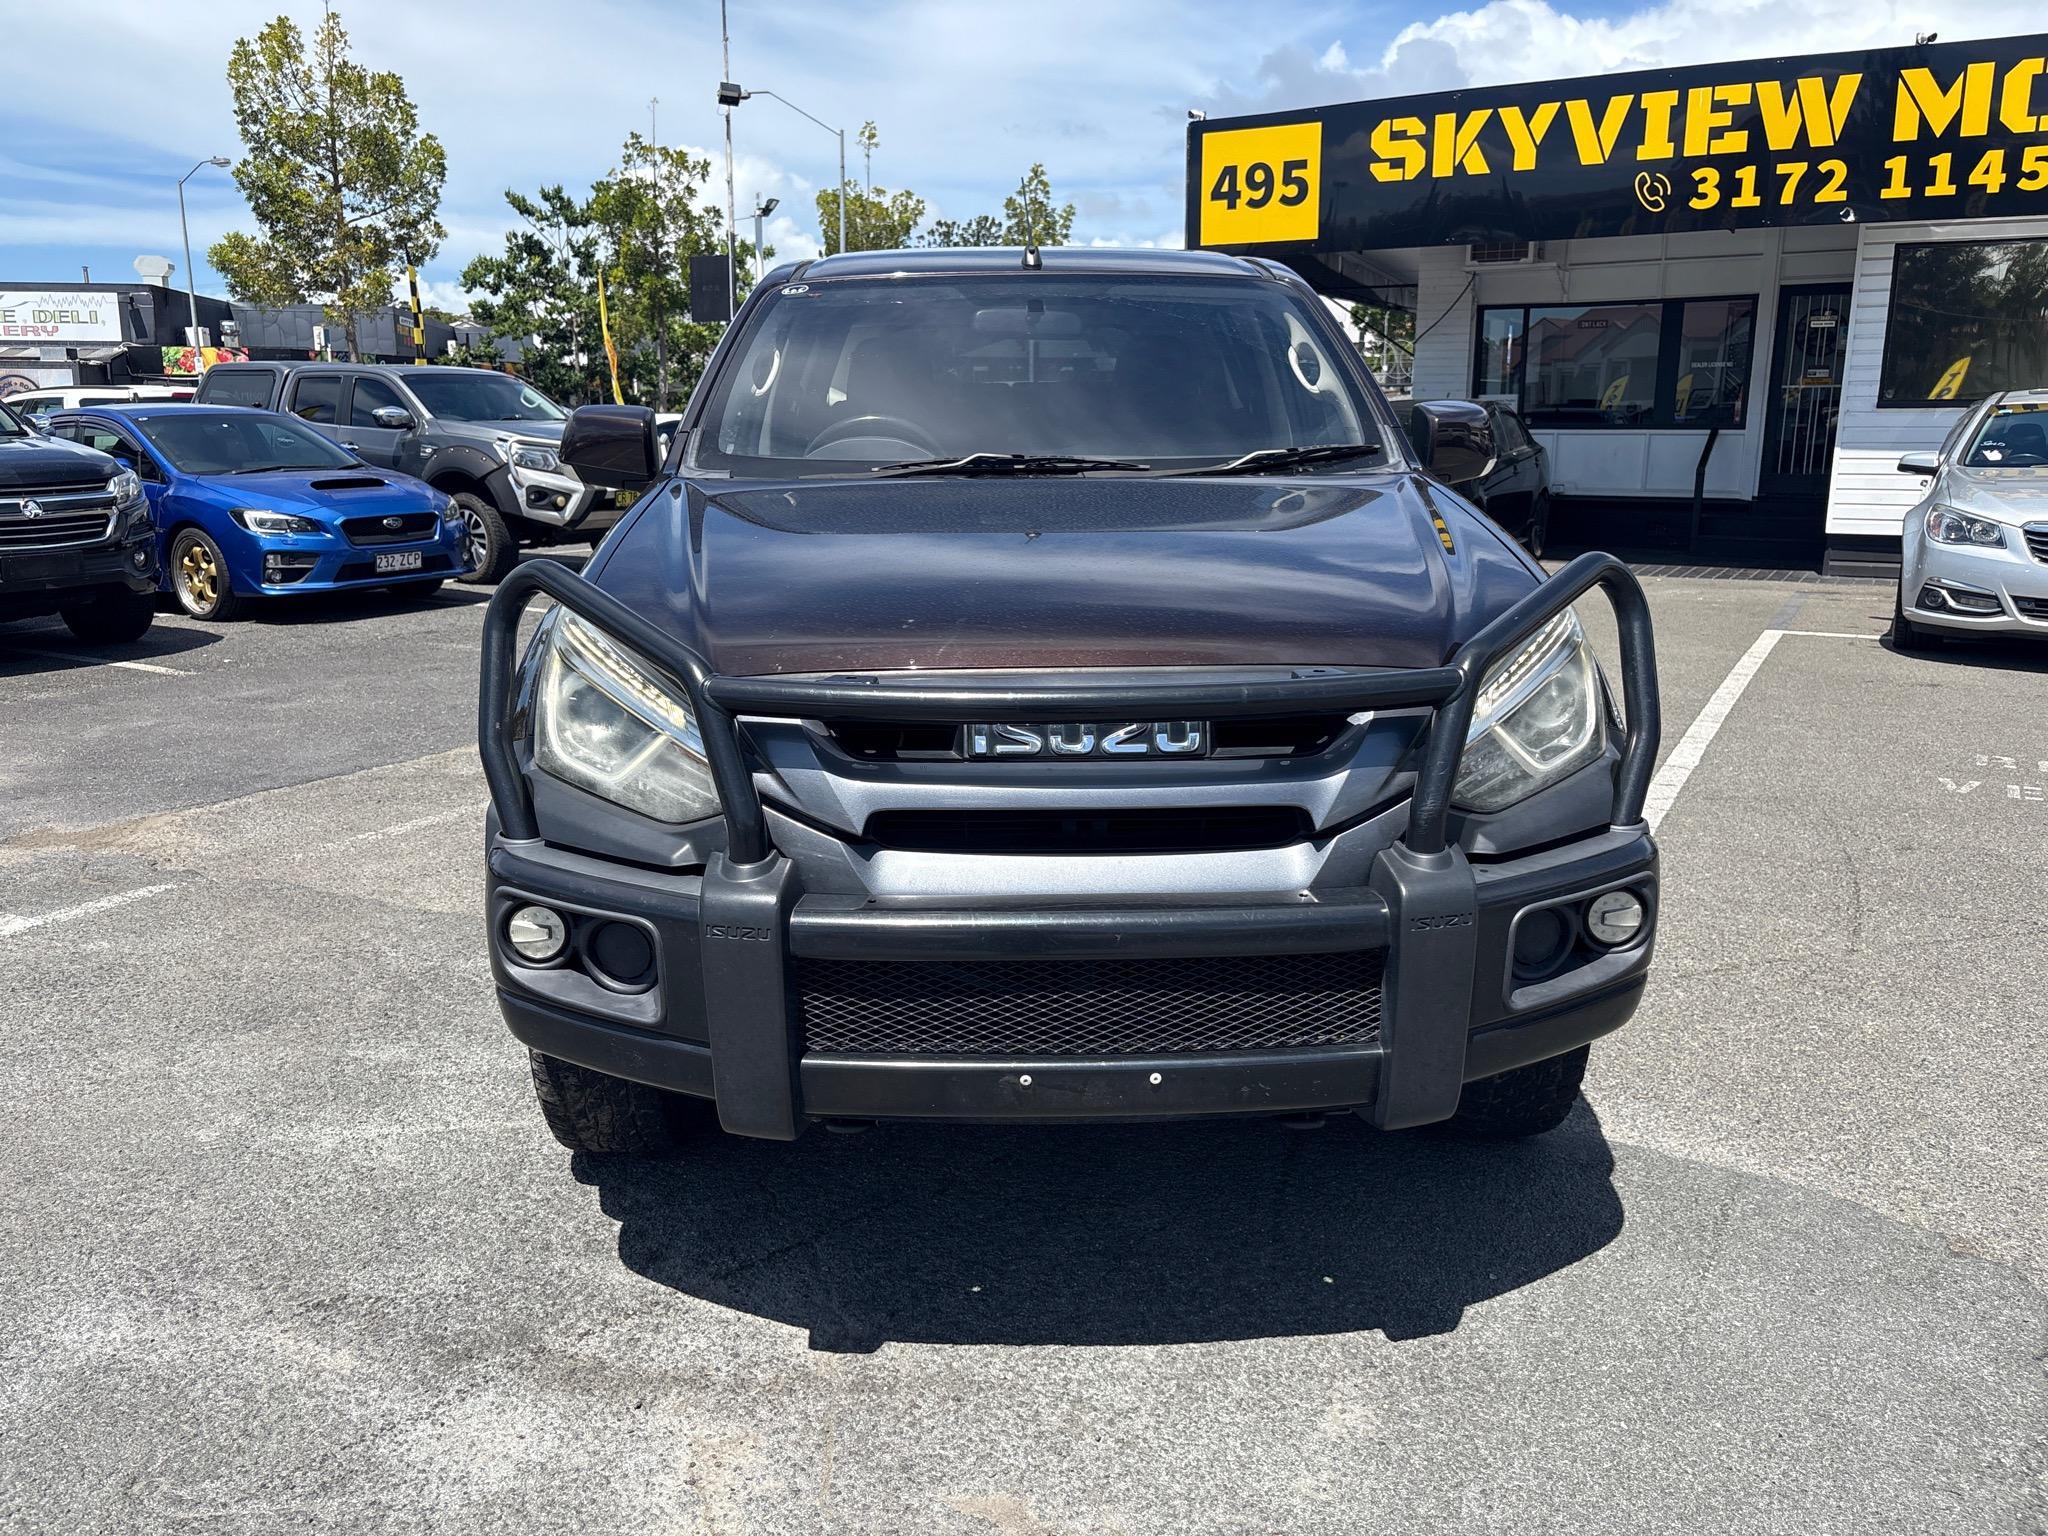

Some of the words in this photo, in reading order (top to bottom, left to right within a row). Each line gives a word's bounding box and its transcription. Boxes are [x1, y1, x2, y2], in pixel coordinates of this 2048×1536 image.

[1369, 73, 1863, 182] SKYVIEW
[1210, 159, 1309, 210] 495
[1688, 159, 1848, 211] 3172
[1880, 144, 2048, 199] 1145
[0, 325, 59, 337] ERY
[377, 555, 396, 570] 232
[400, 552, 421, 567] ZCP
[1410, 912, 1473, 932] ISUZU
[705, 924, 772, 942] ISUZU
